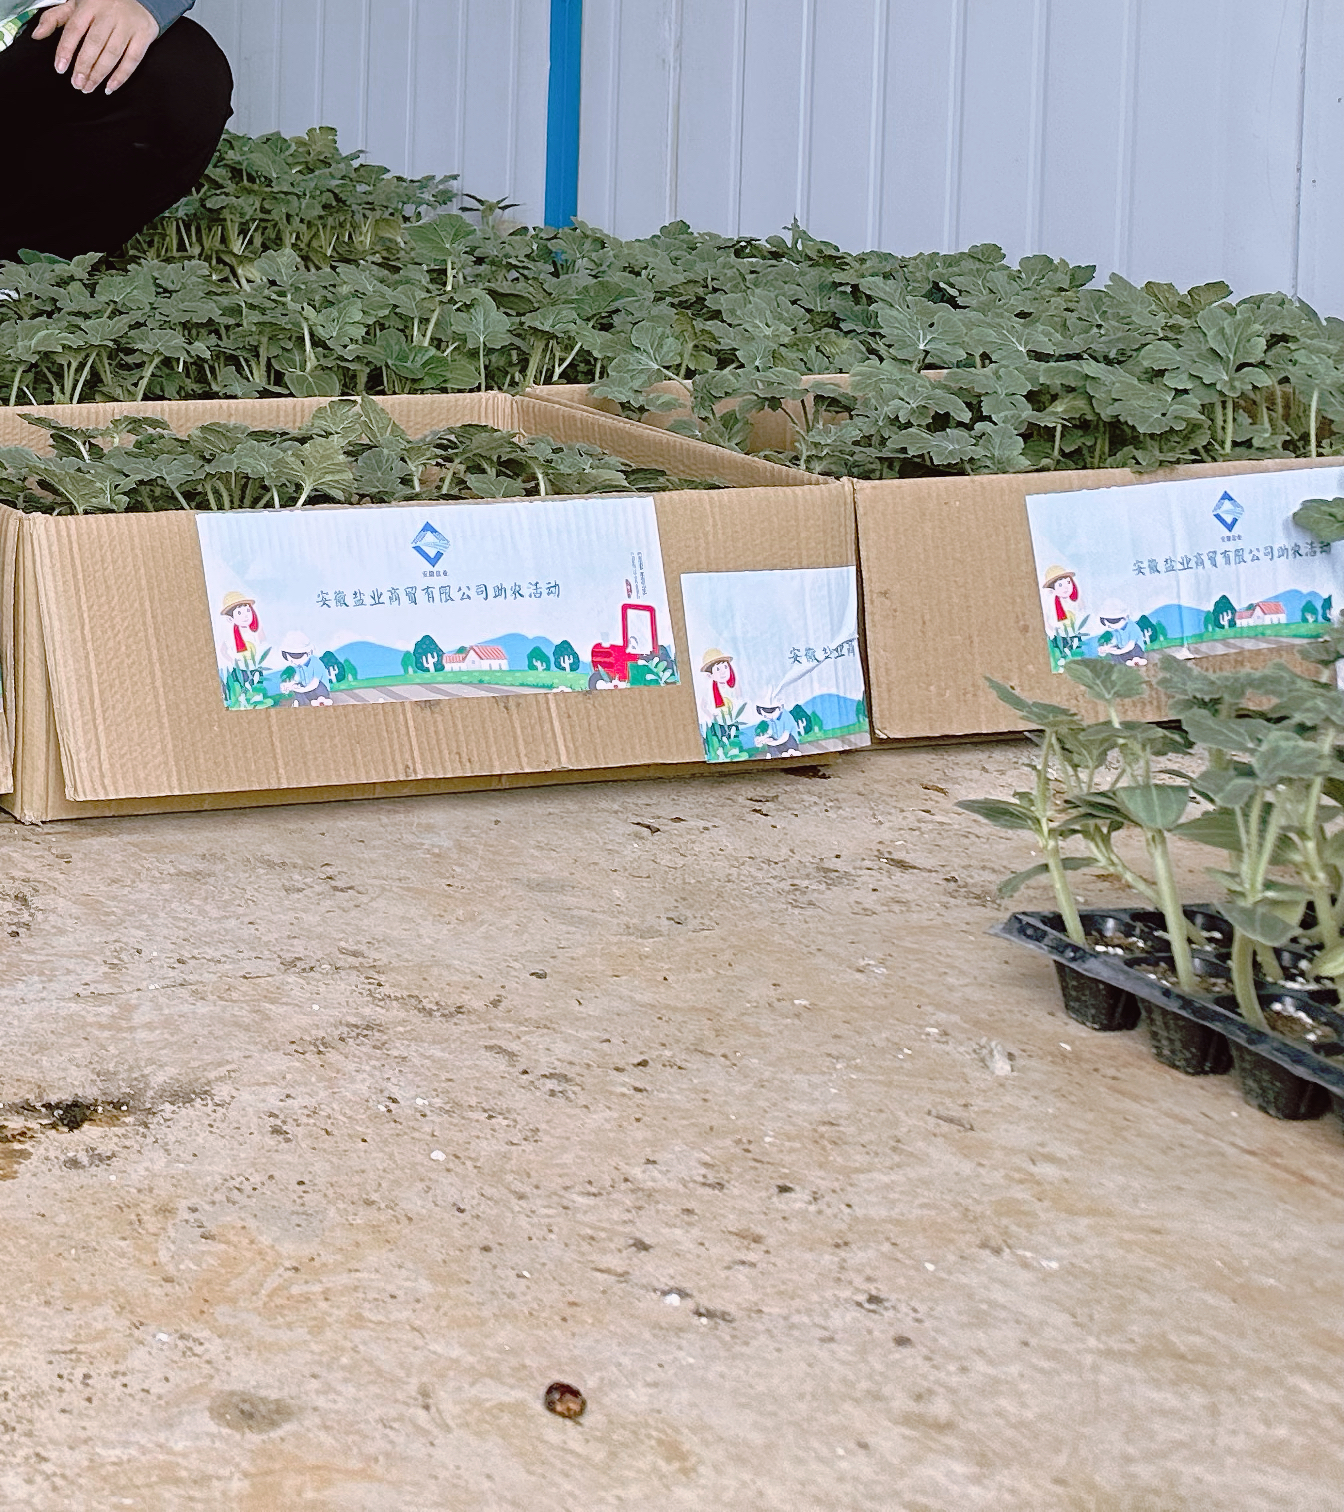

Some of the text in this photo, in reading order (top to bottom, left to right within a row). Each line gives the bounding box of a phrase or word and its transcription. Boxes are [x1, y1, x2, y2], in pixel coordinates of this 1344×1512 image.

[315, 580, 561, 609] 安徽盐业商贸有限公司助农活动
